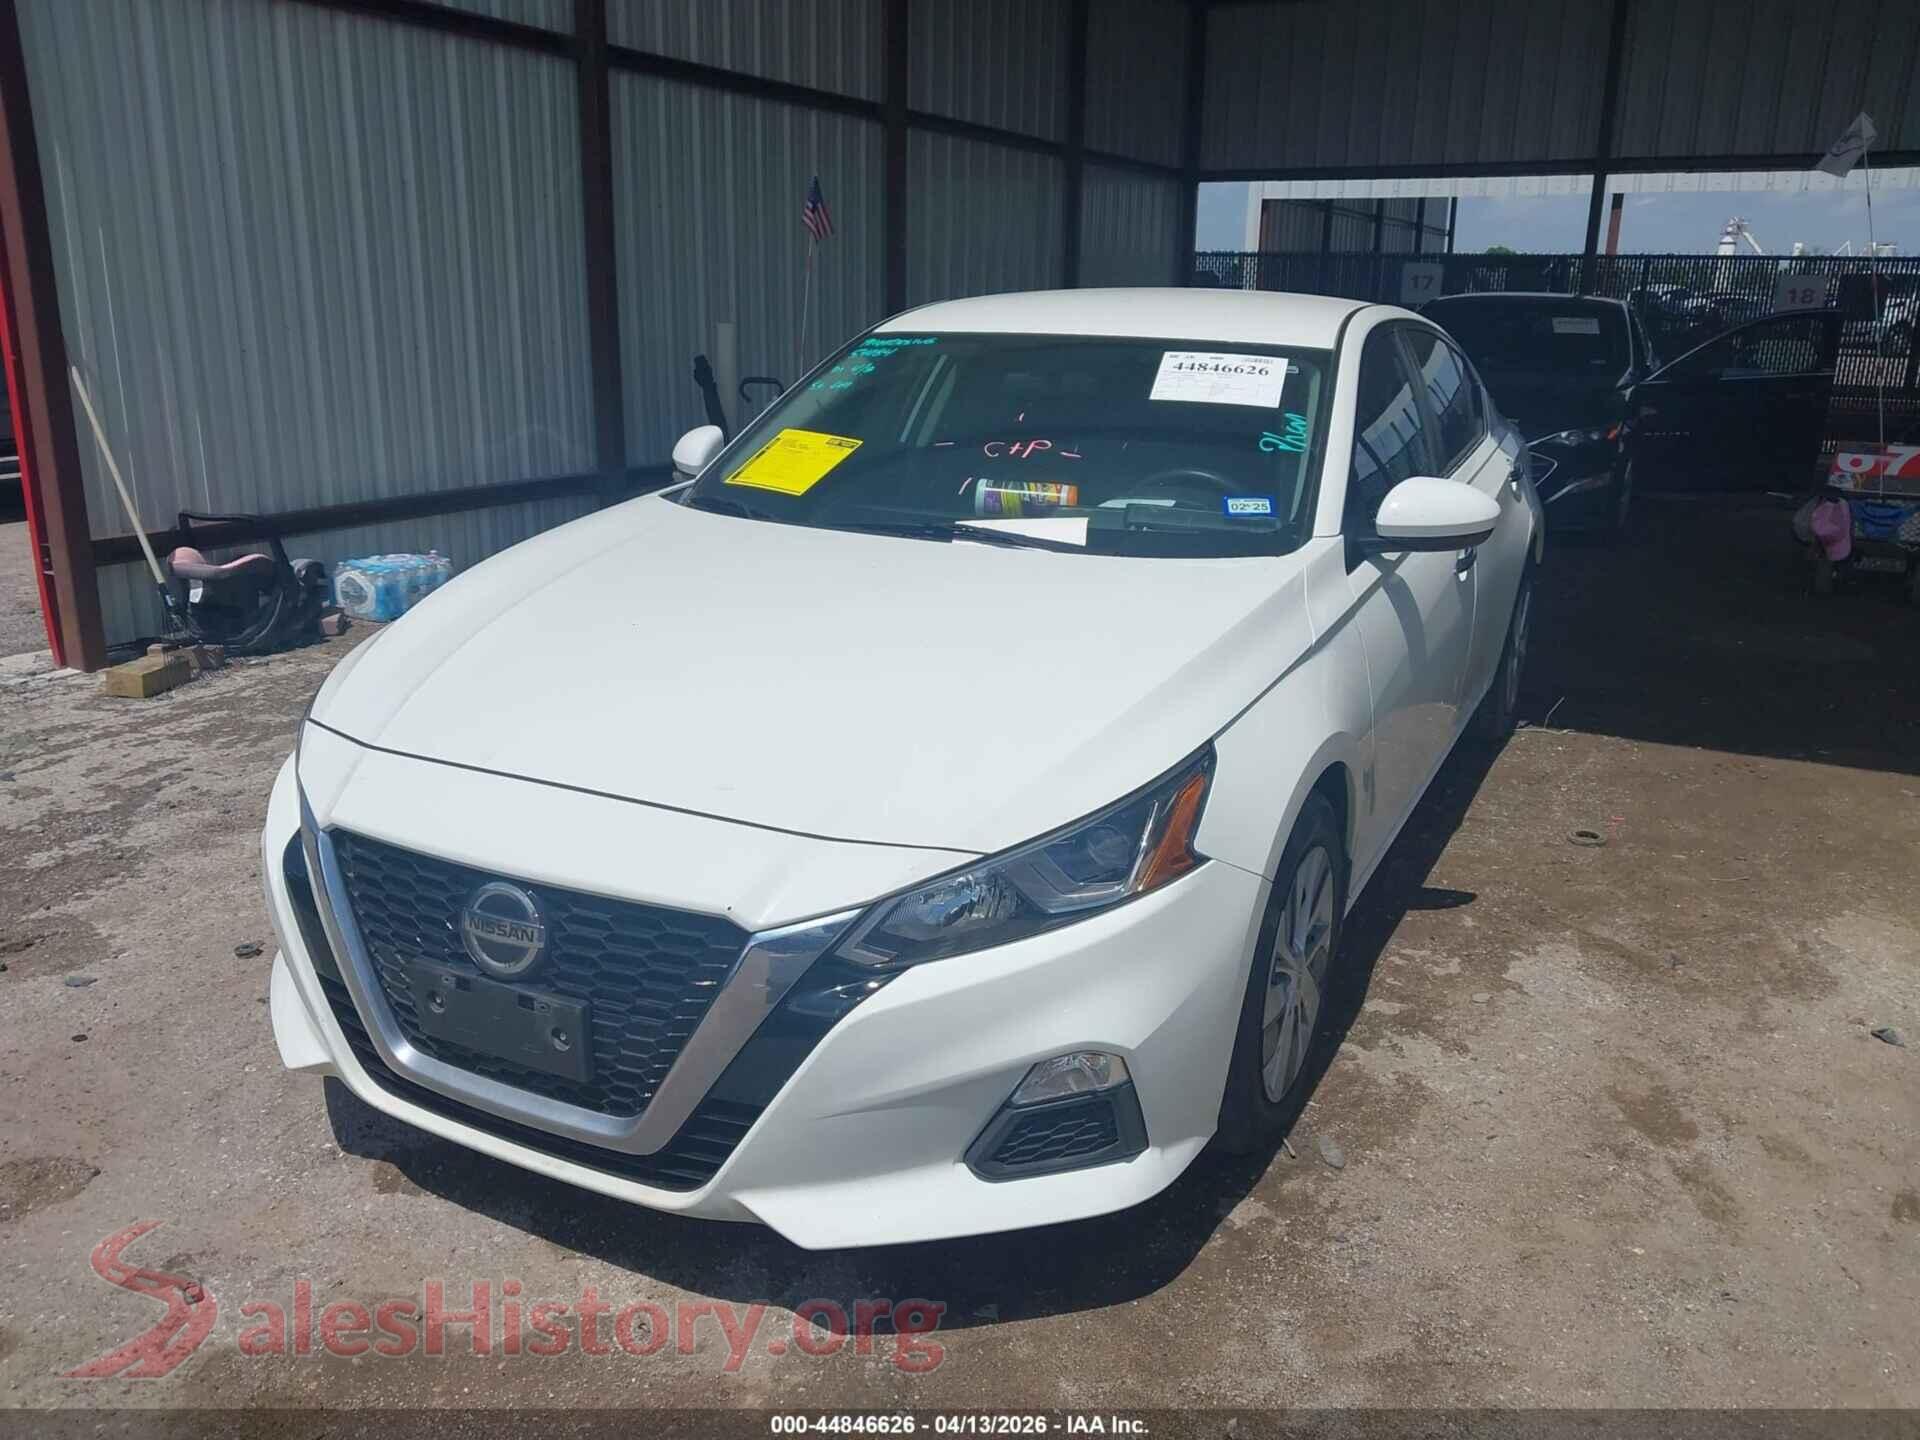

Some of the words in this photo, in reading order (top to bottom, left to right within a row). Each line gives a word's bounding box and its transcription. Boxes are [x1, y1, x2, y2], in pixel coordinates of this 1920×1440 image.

[1410, 274, 1435, 289] 17
[1786, 288, 1817, 304] 18
[1172, 361, 1270, 378] 44846626
[468, 917, 535, 944] NISSAN
